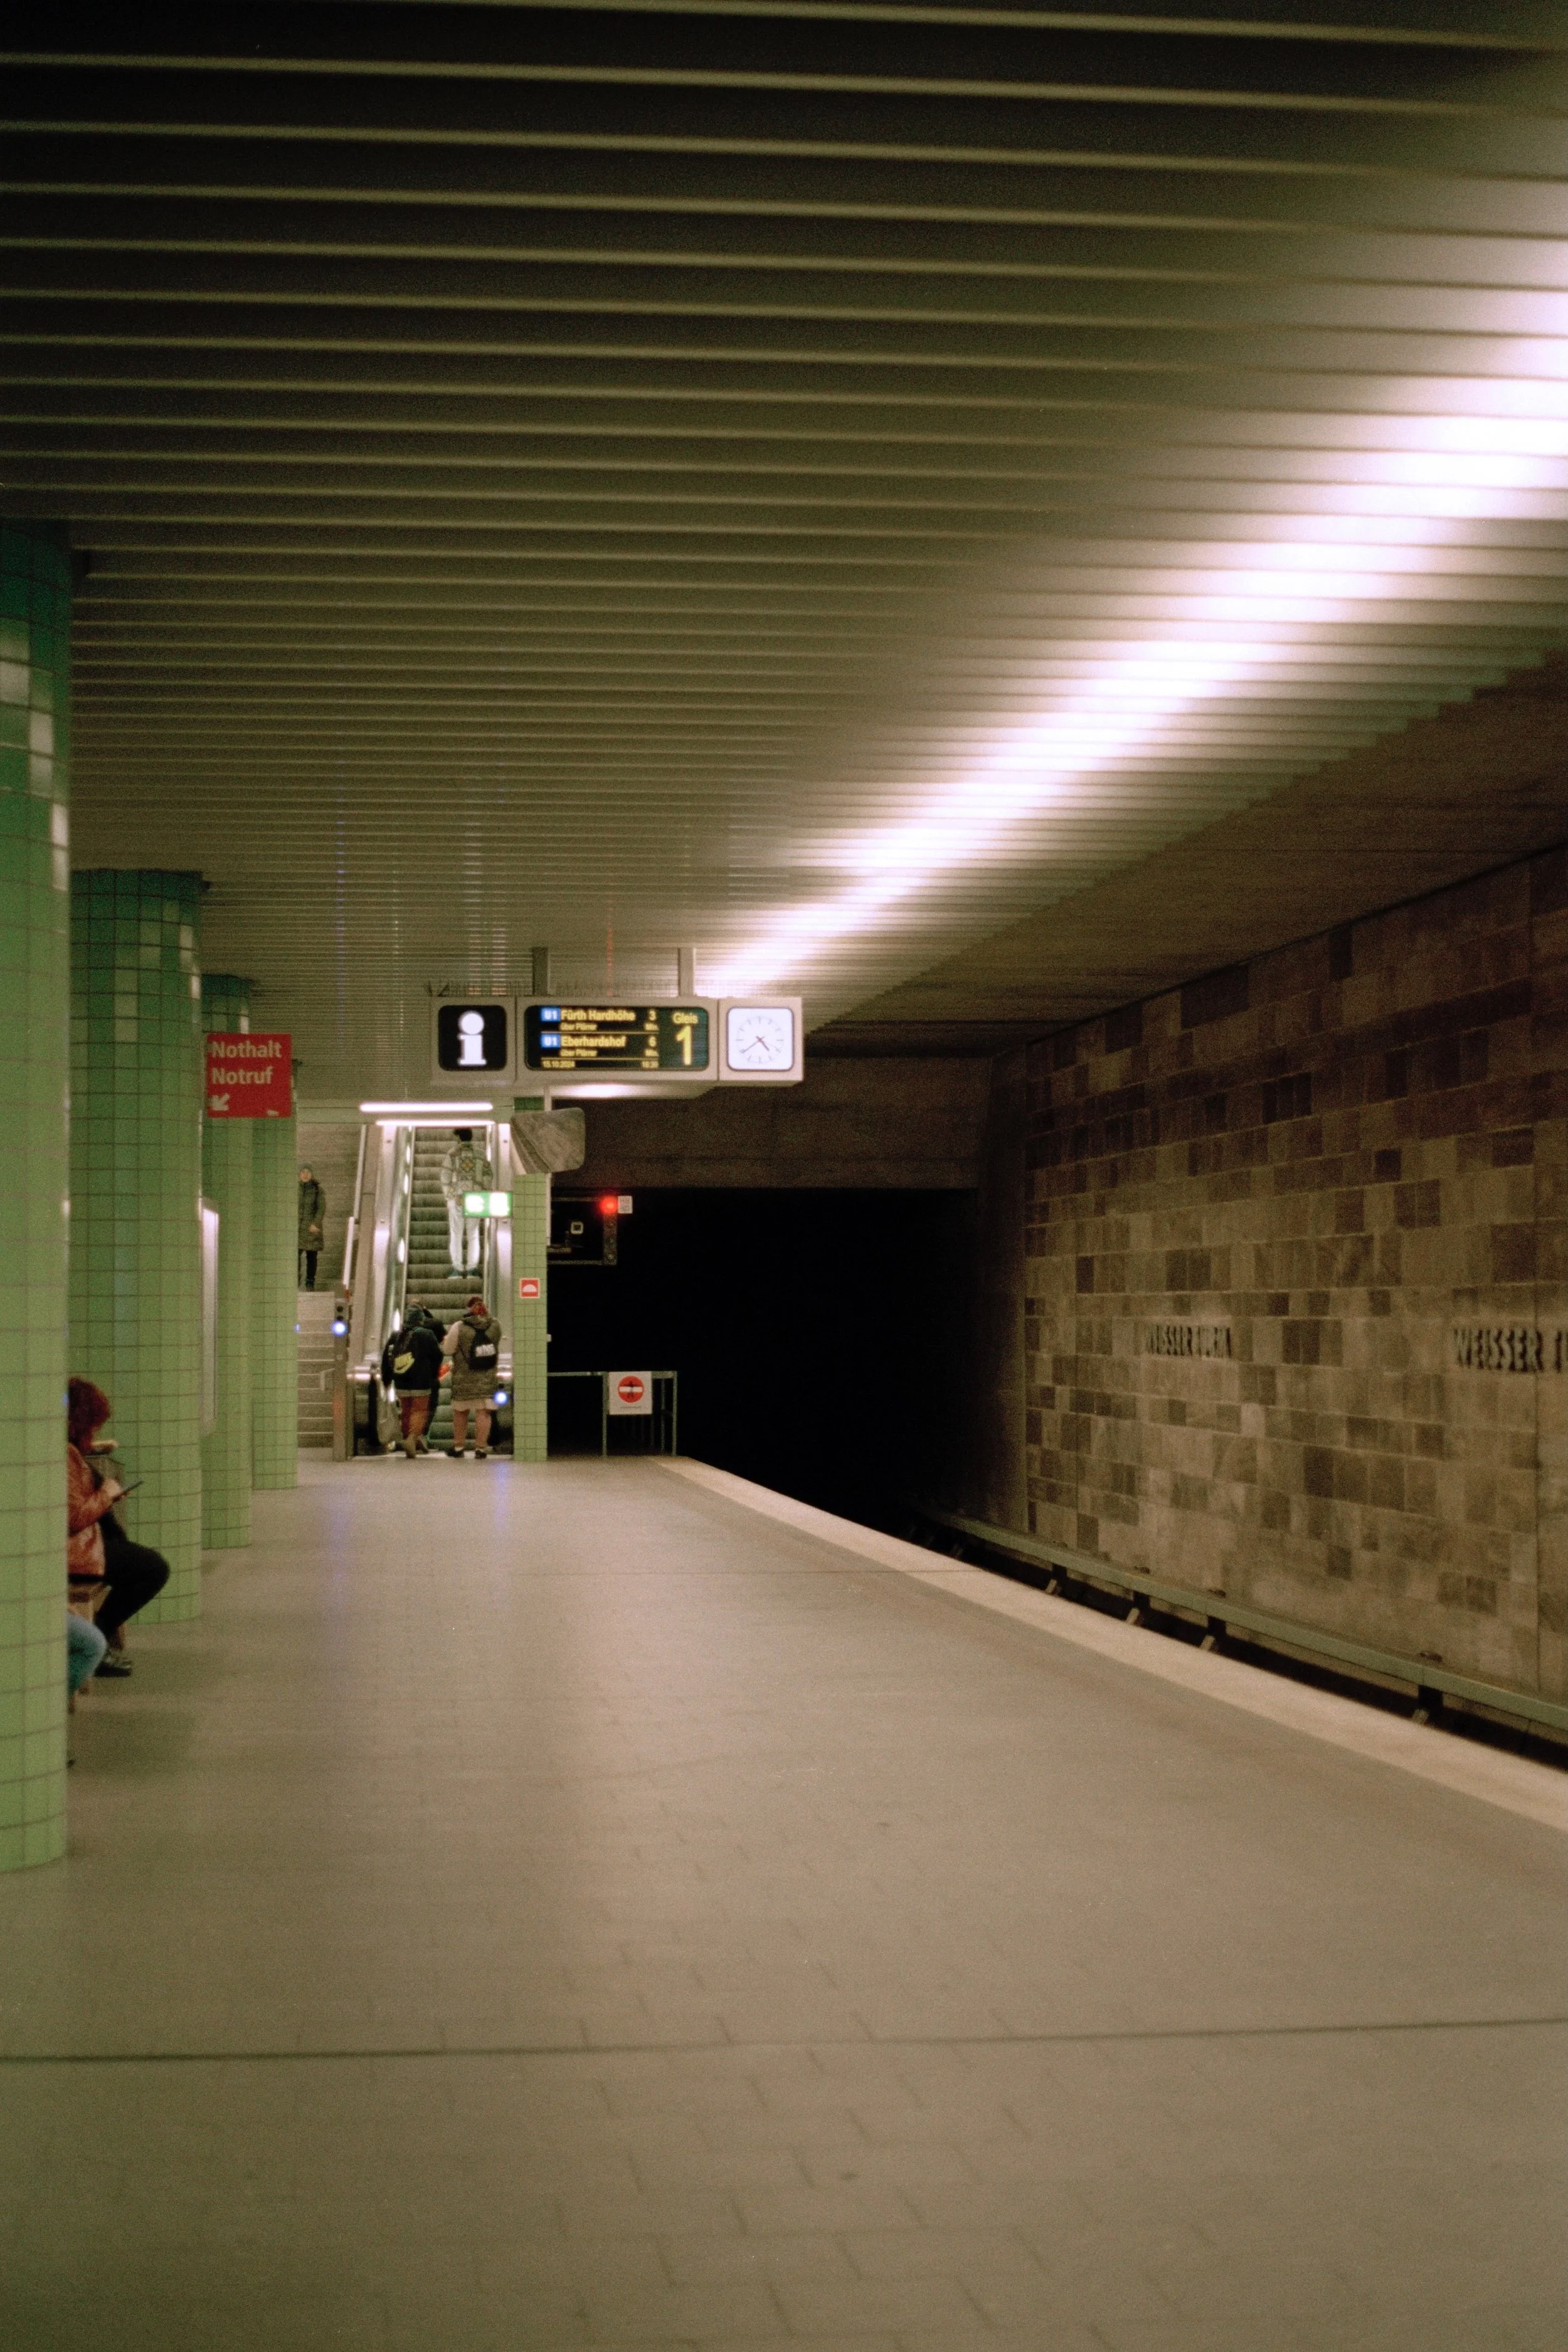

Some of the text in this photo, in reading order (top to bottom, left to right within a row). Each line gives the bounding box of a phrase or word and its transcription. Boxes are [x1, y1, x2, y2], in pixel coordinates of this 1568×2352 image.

[544, 1009, 657, 1021] U1 Fürth Hardhöhe 3
[672, 1011, 698, 1024] Gleis
[210, 1040, 282, 1059] Nothalt
[544, 1035, 657, 1047] U1 Eberhardshof 6
[675, 1025, 692, 1066] 1
[211, 1066, 274, 1085] Notruf
[1453, 1328, 1544, 1372] WEISSER
